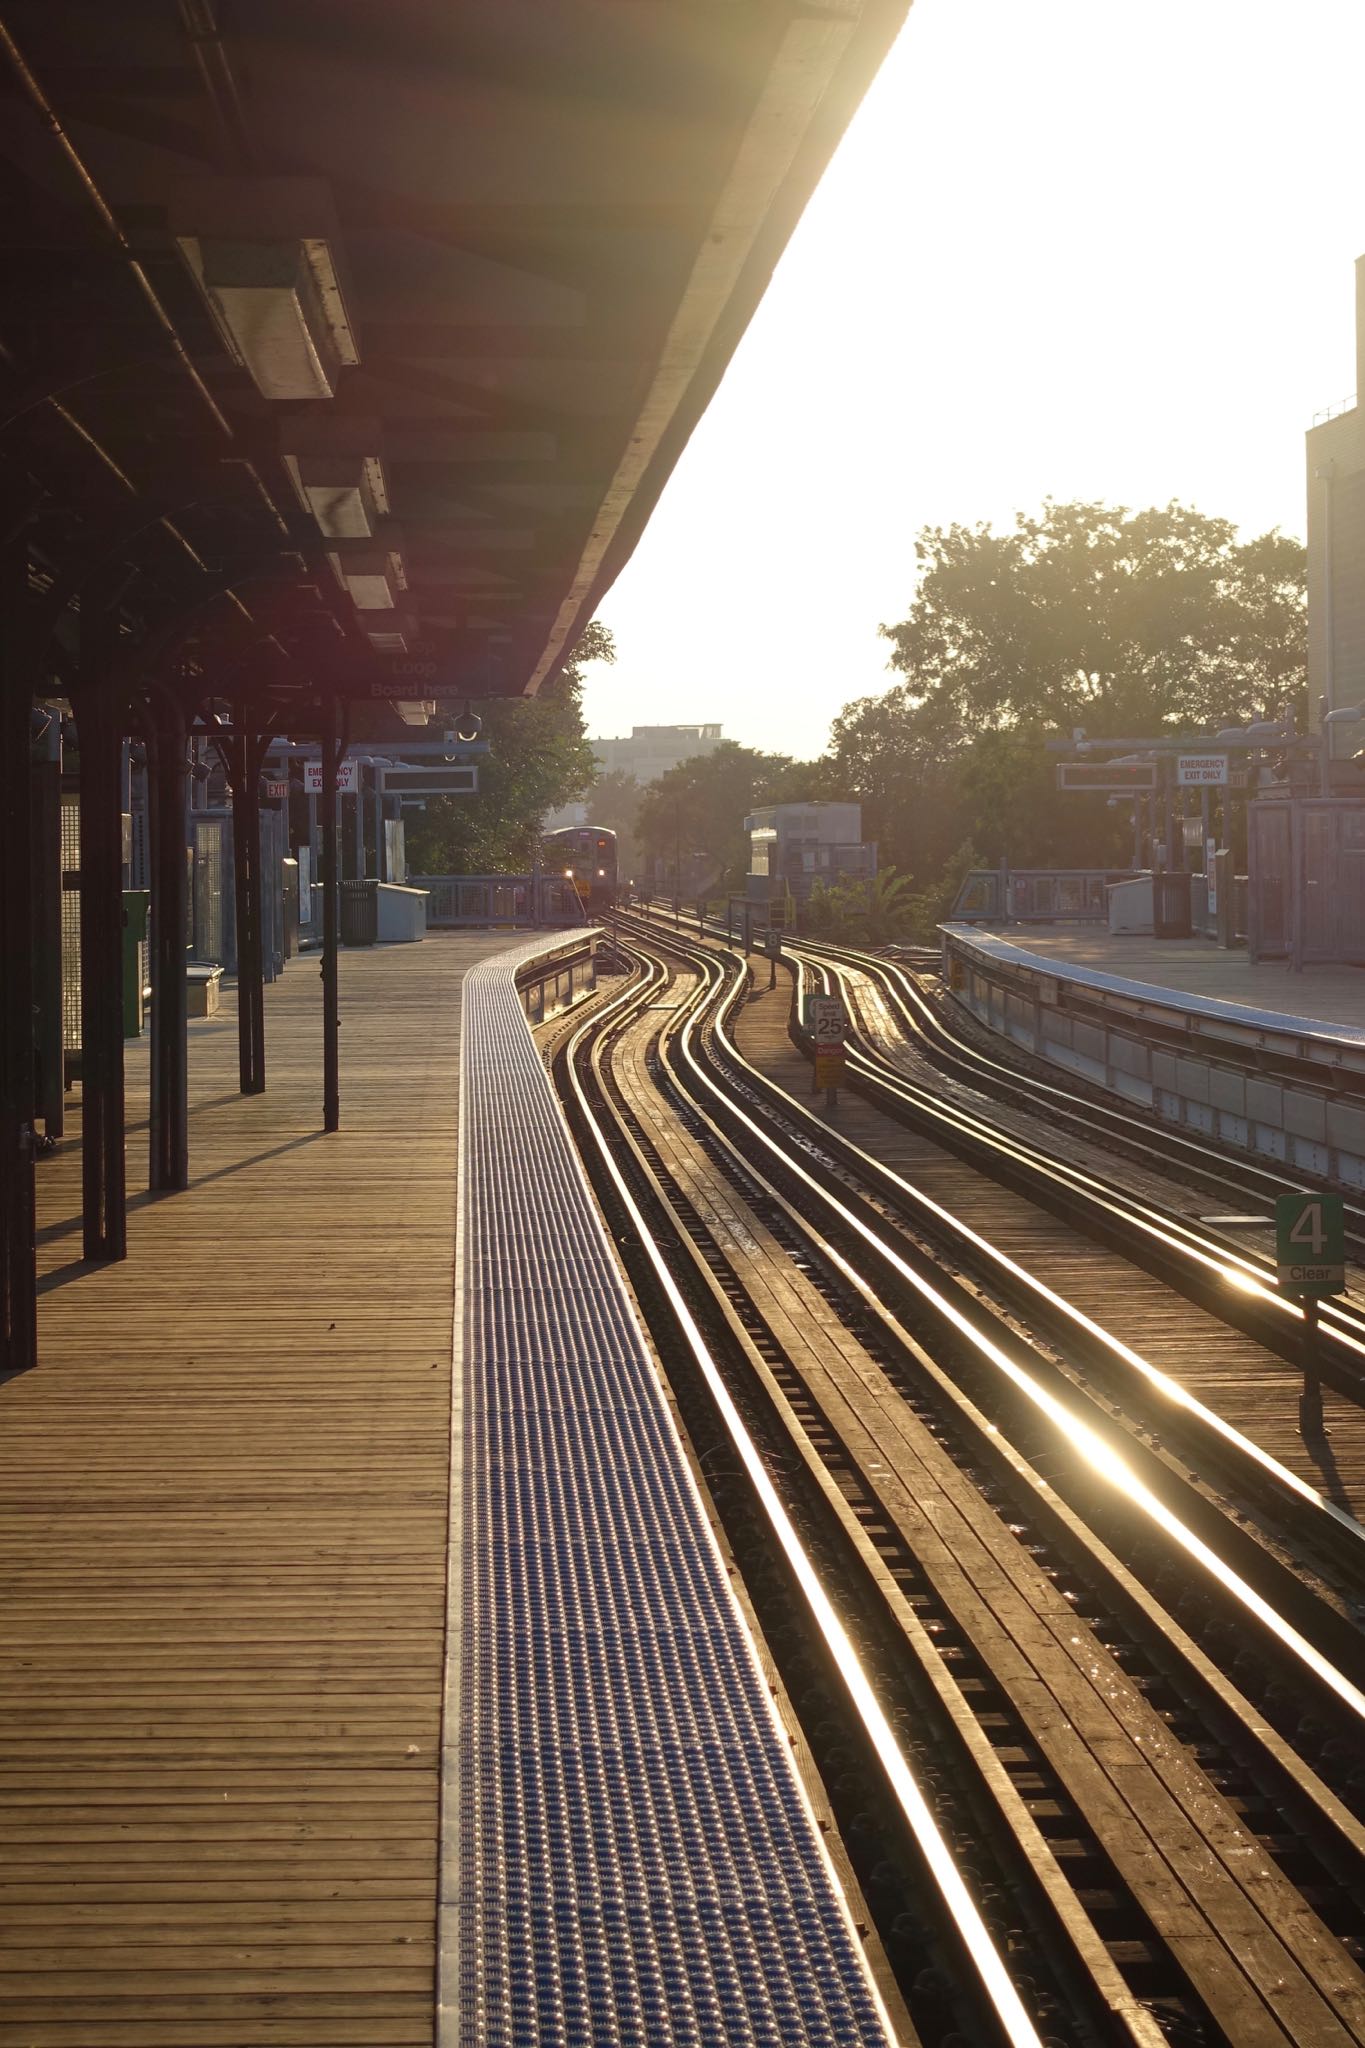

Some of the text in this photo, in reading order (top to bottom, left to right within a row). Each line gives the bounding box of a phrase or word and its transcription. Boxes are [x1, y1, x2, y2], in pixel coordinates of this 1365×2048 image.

[370, 679, 458, 696] Board here
[1180, 759, 1225, 769] EMERGENCY
[308, 767, 353, 776] EMENCY
[1184, 770, 1201, 780] EXIT
[1202, 770, 1221, 780] ONLY
[268, 783, 287, 796] EXIT
[818, 1018, 842, 1035] 25
[1289, 1203, 1328, 1254] 4
[1290, 1266, 1331, 1280] Clear
